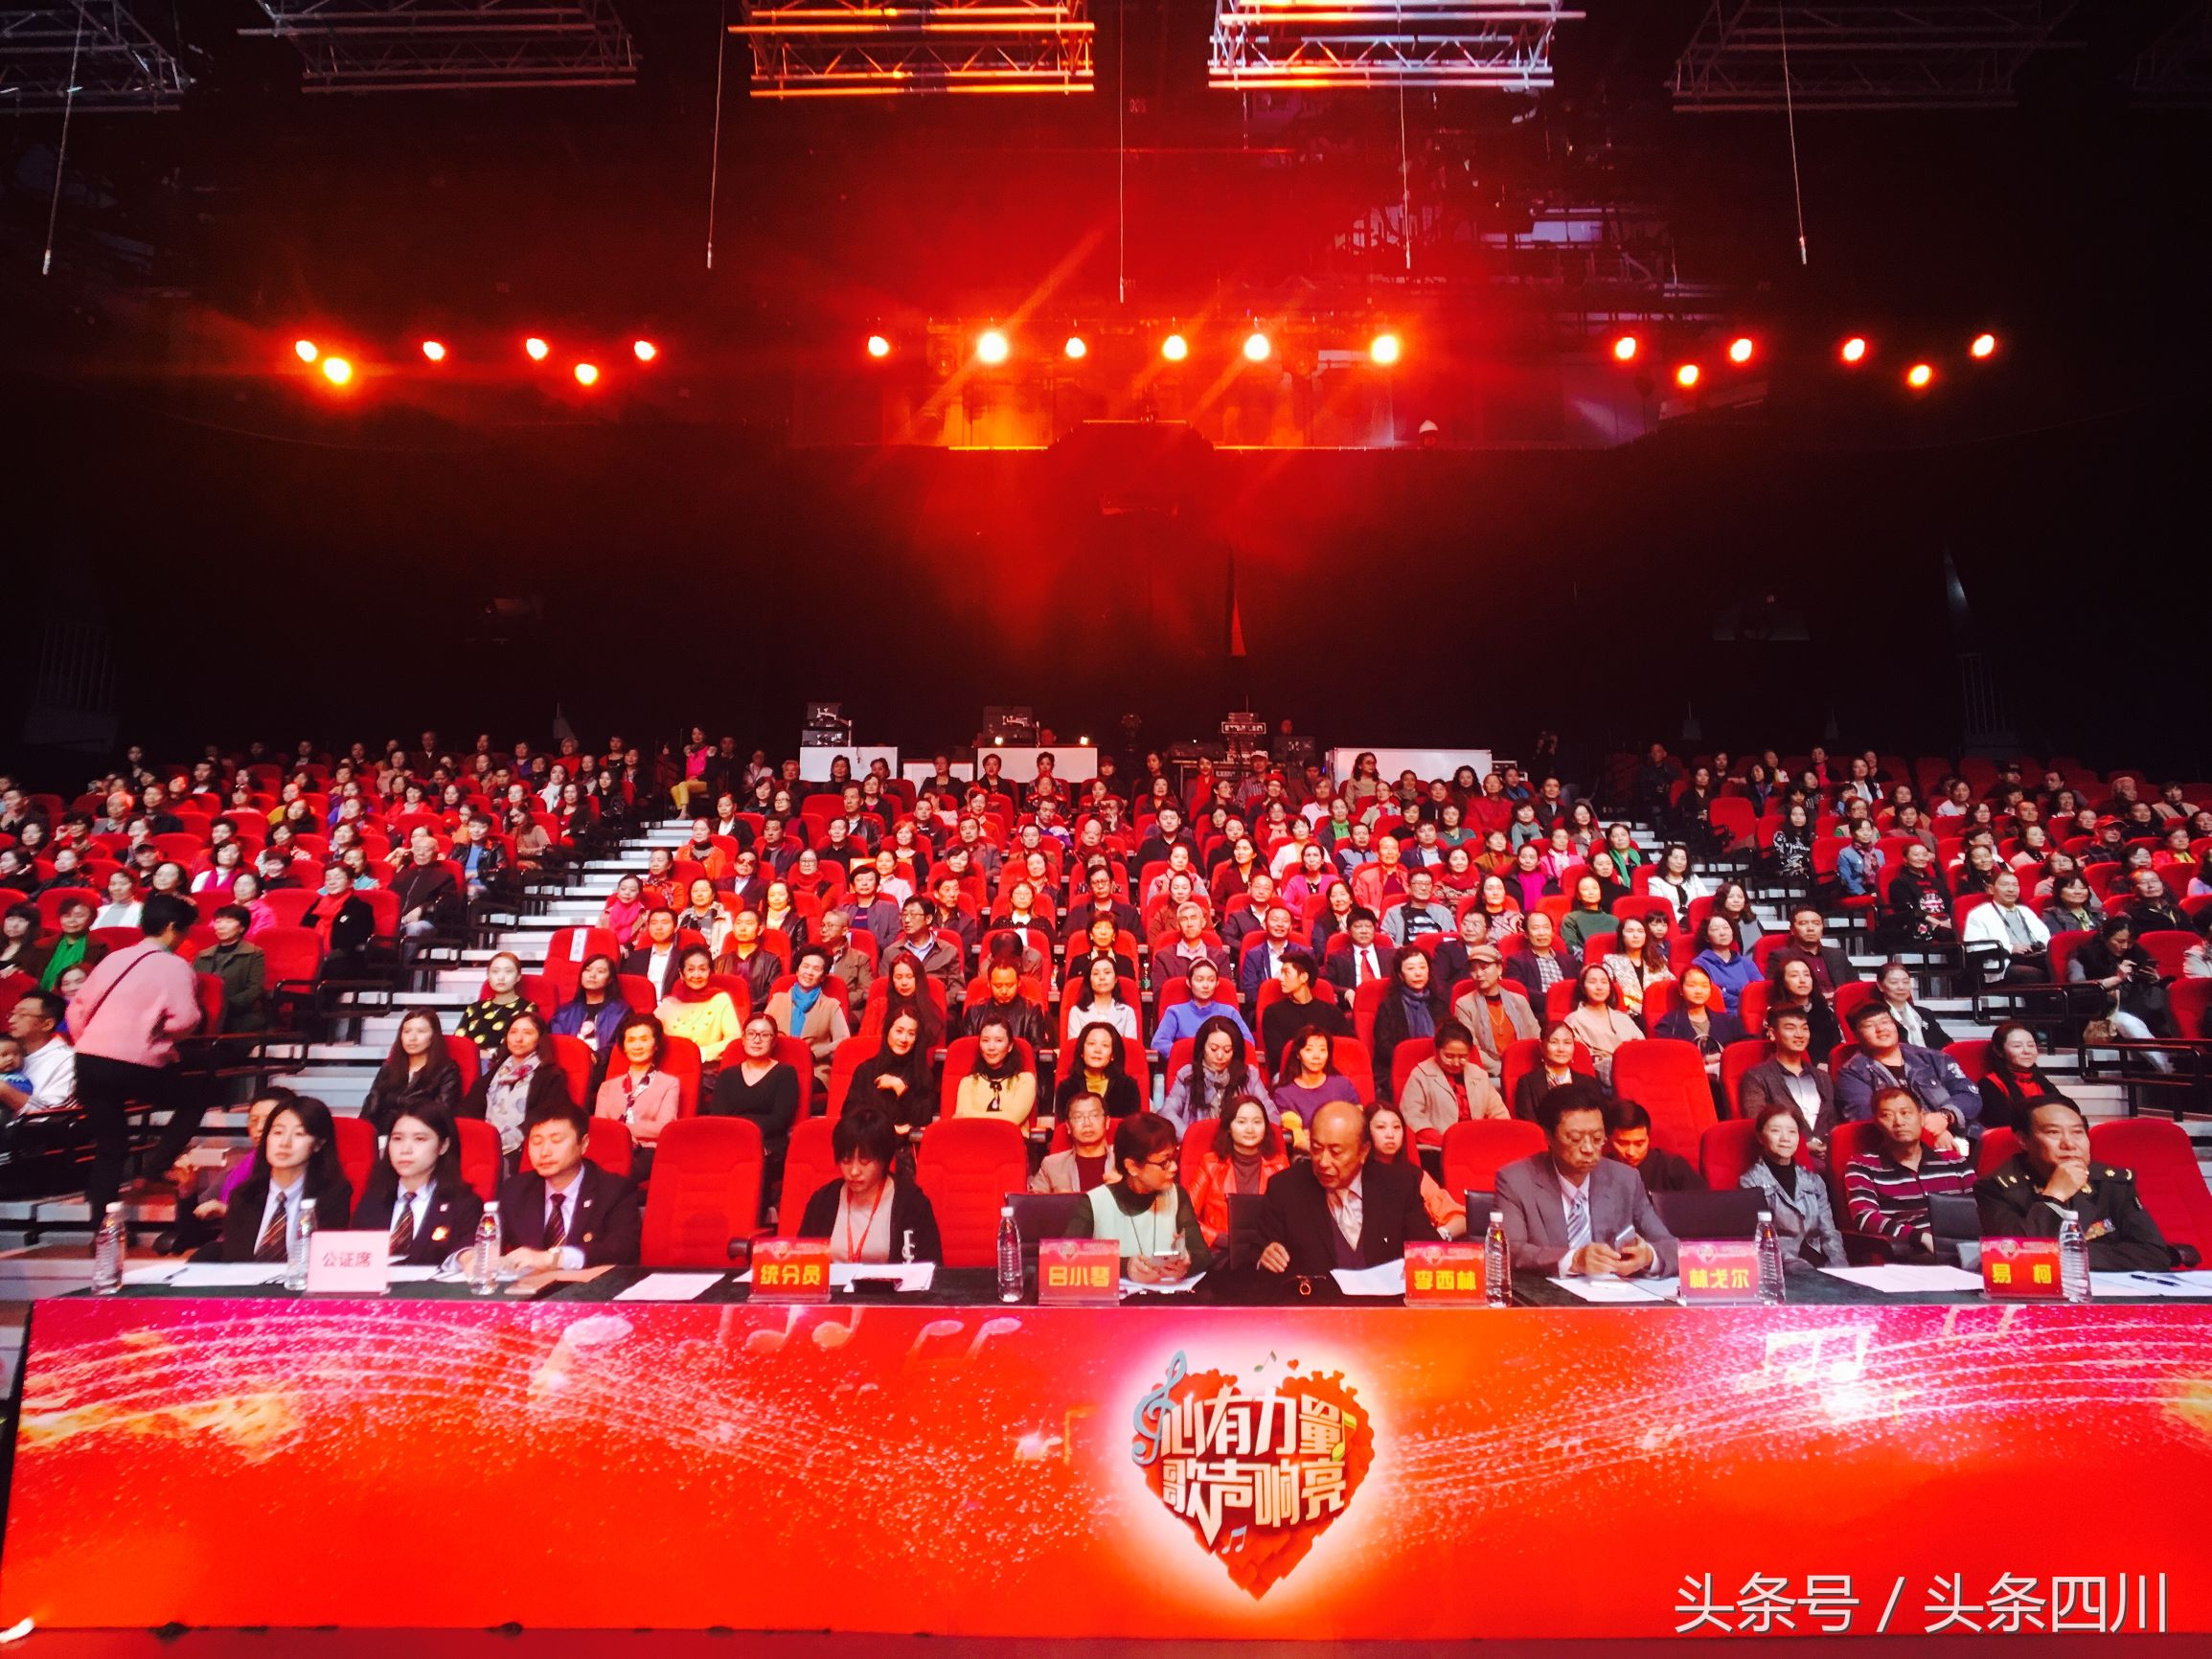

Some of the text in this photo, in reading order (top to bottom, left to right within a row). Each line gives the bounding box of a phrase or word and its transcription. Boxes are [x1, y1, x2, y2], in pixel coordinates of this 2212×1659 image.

[323, 1251, 372, 1267] 公证席
[760, 1263, 821, 1285] 统分员
[1048, 1265, 1110, 1287] 吕小琴
[1414, 1269, 1476, 1290] 李西林
[1689, 1267, 1750, 1289] 林戈尔
[1160, 1386, 1342, 1458] 心有力量
[1162, 1456, 1347, 1546] 歌声响亮
